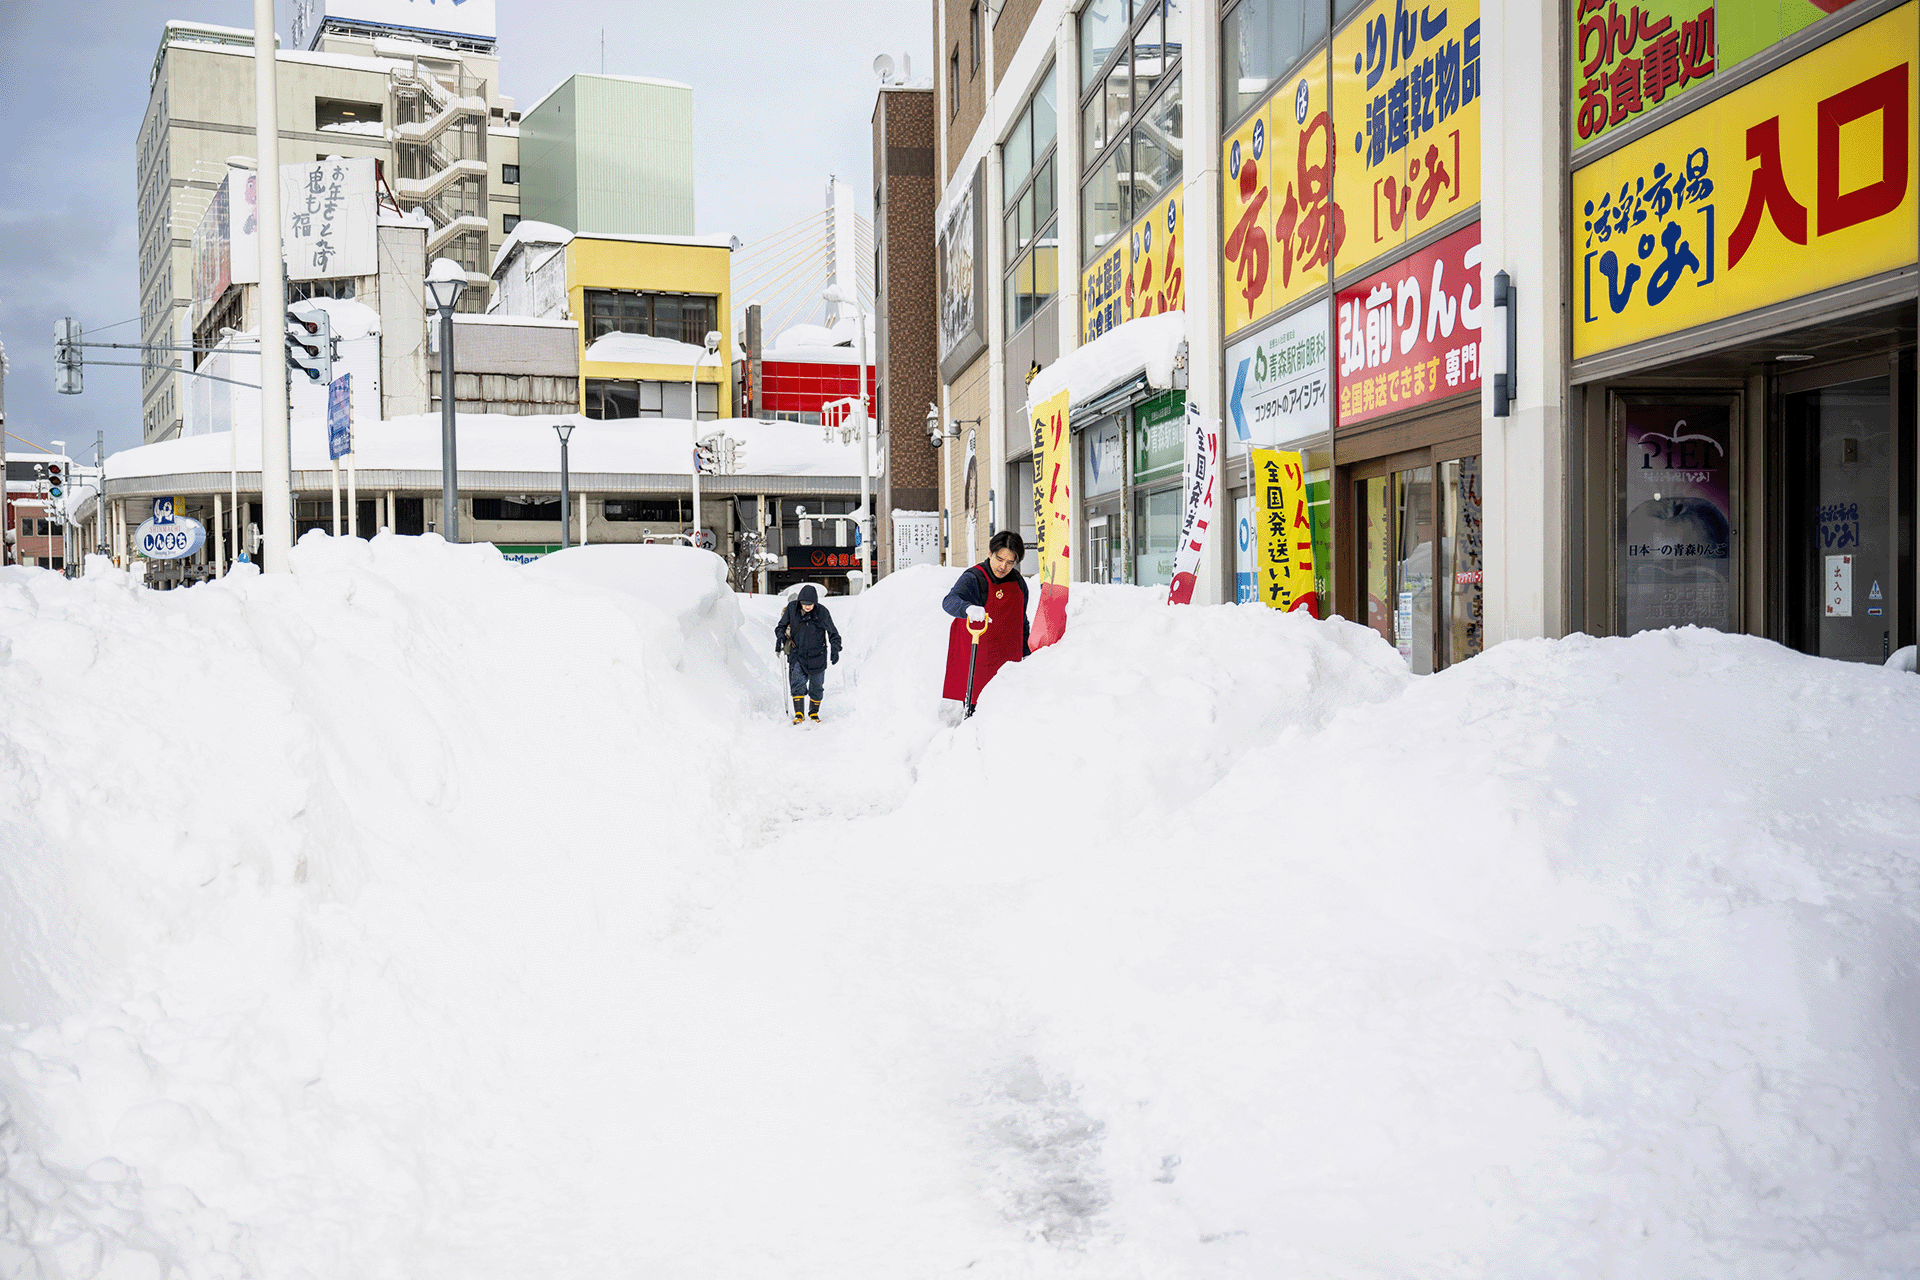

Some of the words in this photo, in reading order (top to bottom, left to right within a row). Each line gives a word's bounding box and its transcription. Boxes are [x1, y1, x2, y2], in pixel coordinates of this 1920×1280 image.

[1366, 17, 1481, 172] 海産乾物品
[1577, 6, 1714, 139] お食事処
[1728, 61, 1909, 271] 入口
[1225, 111, 1346, 319] 市場
[1269, 330, 1326, 383] 青森駅前眼科
[1340, 356, 1440, 418] 全国発送できます
[1446, 342, 1482, 387] 専門
[1255, 380, 1327, 422] コンタクトのアイシティ
[144, 532, 187, 551] しんまち
[1263, 461, 1292, 611] 全国発送いた
[1628, 543, 1727, 557] 日本一の青森りんご
[1833, 566, 1843, 605] 出入口
